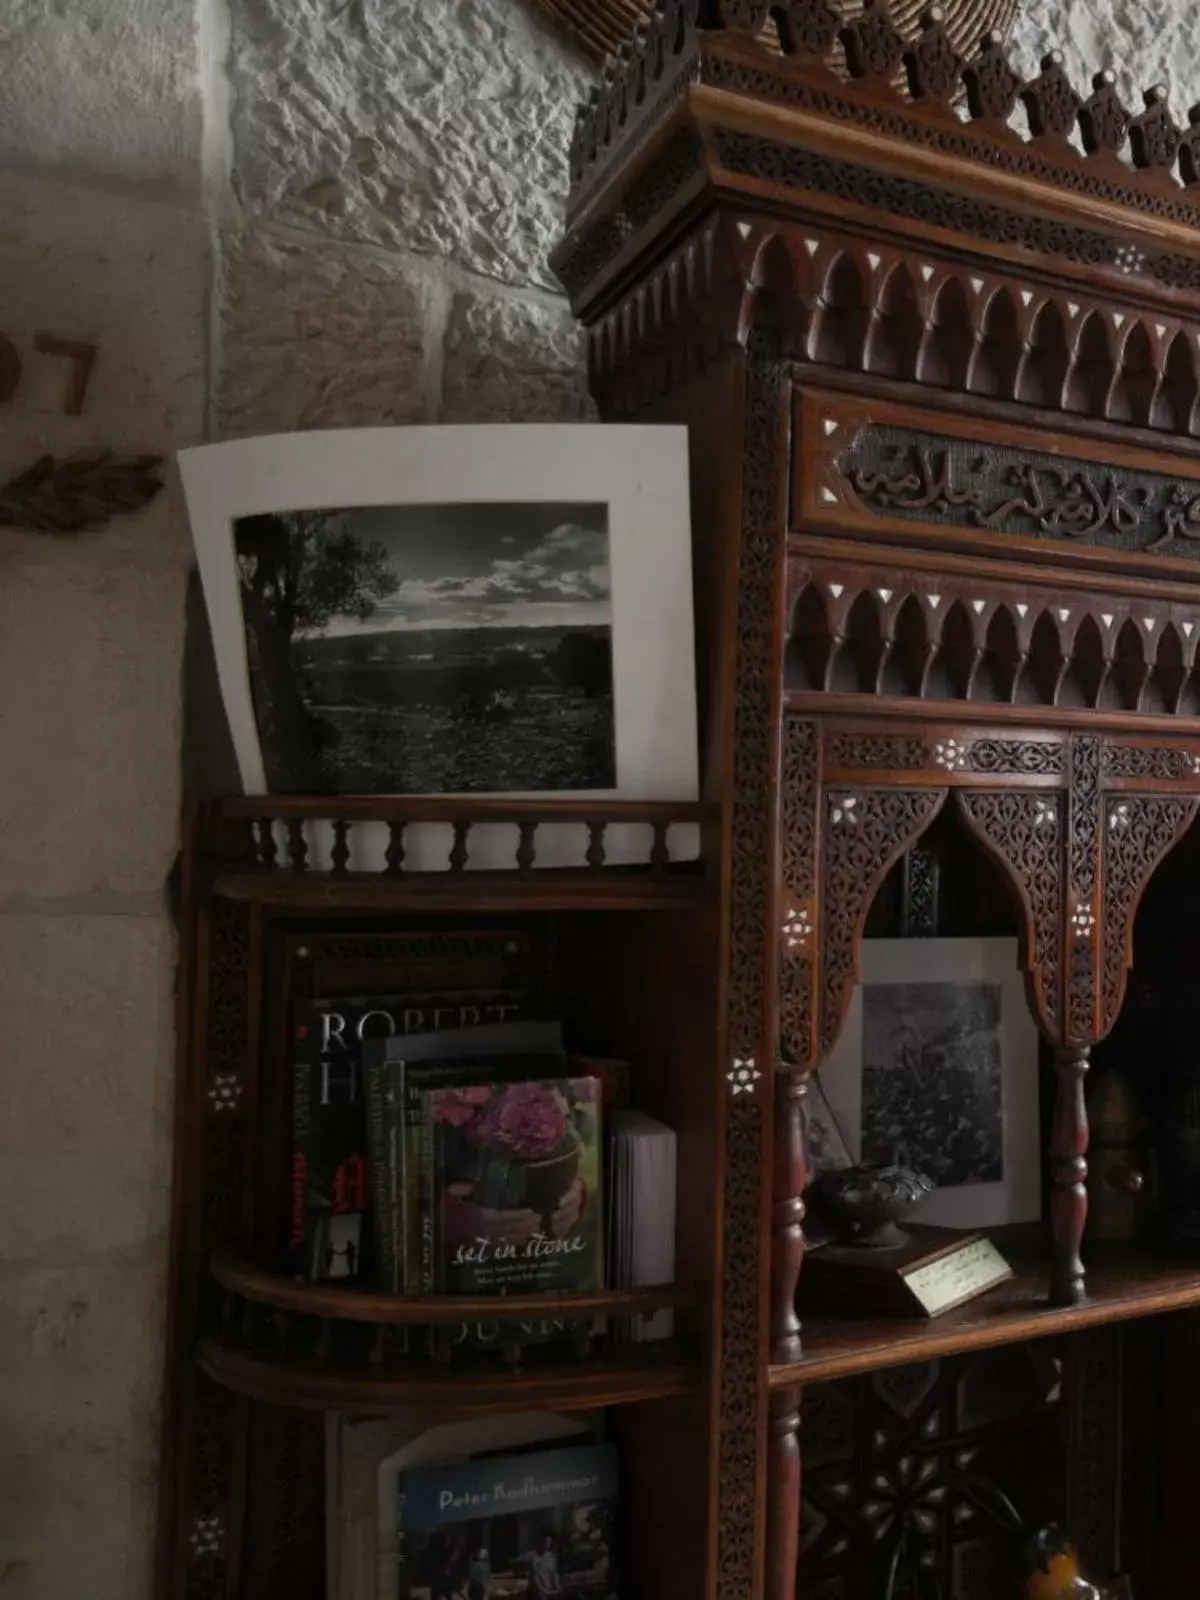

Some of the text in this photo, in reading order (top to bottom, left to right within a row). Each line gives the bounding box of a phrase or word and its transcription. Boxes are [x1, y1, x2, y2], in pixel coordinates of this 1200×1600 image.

[451, 1231, 589, 1266] set in stone
[438, 1488, 492, 1513] Peter
